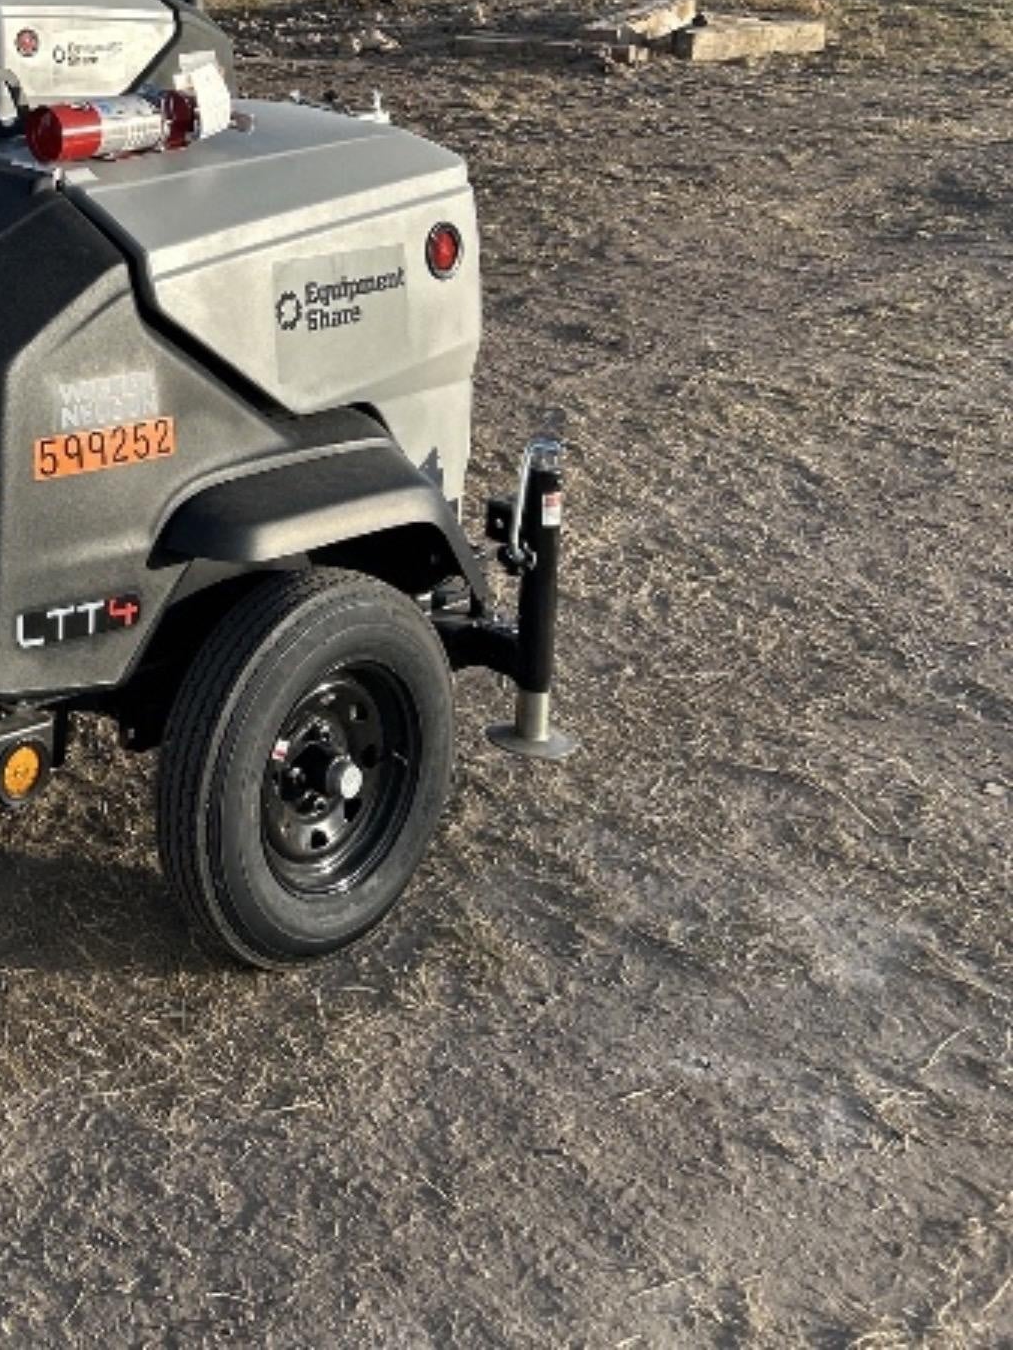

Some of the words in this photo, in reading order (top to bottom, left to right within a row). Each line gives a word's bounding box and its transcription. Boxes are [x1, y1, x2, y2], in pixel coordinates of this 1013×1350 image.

[304, 266, 405, 306] Equipment
[307, 305, 361, 331] Share
[39, 418, 172, 476] 599252
[15, 598, 138, 648] LTT4
